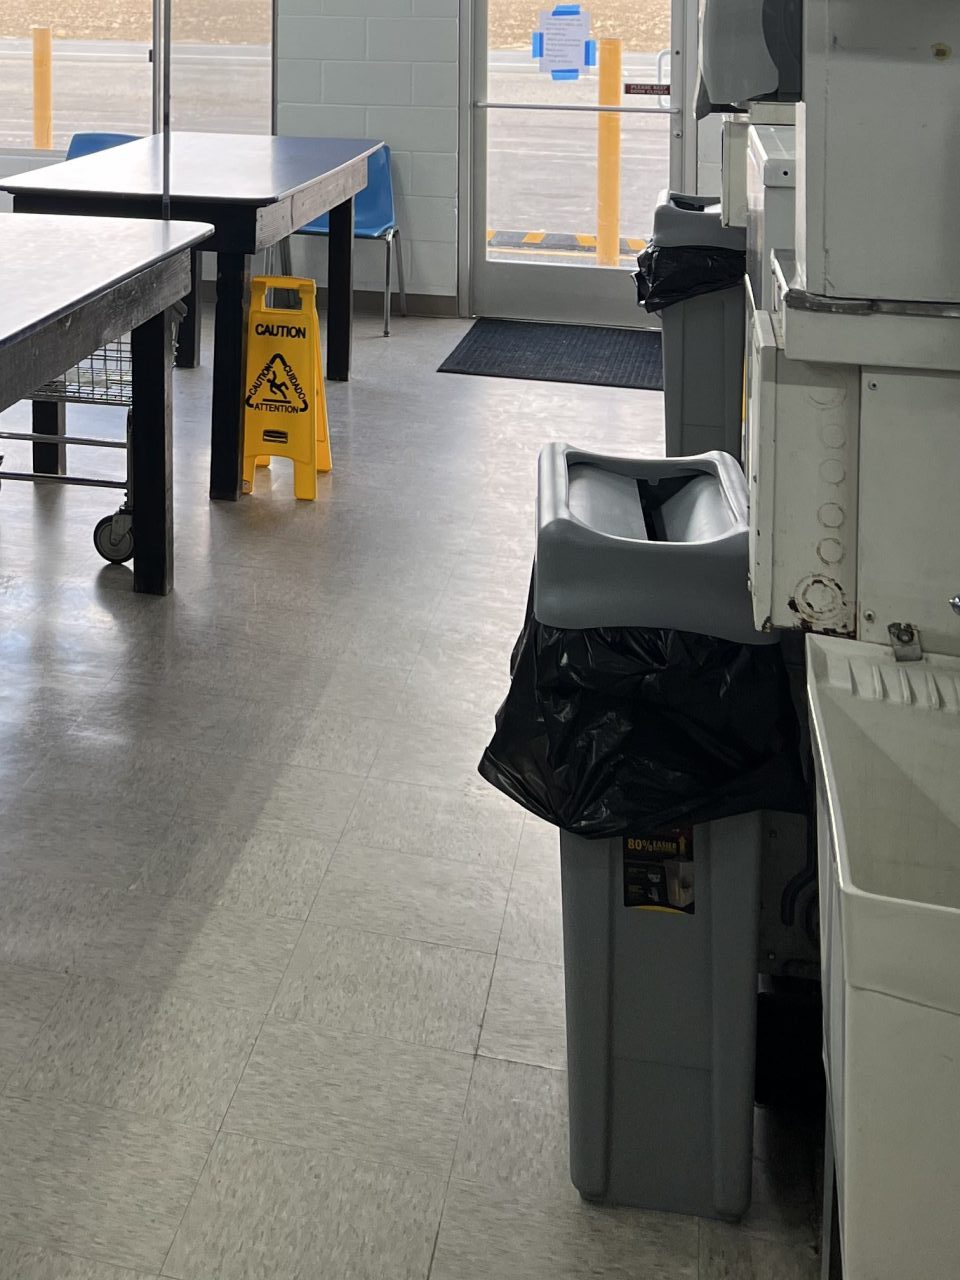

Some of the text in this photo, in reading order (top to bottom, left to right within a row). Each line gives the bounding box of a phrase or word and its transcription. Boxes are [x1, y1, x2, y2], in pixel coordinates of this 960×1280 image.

[255, 323, 307, 339] CAUTION
[248, 363, 274, 396] CAUTION
[283, 364, 306, 400] CUIDADO
[253, 402, 300, 415] ATTENTION
[627, 838, 652, 852] 80%
